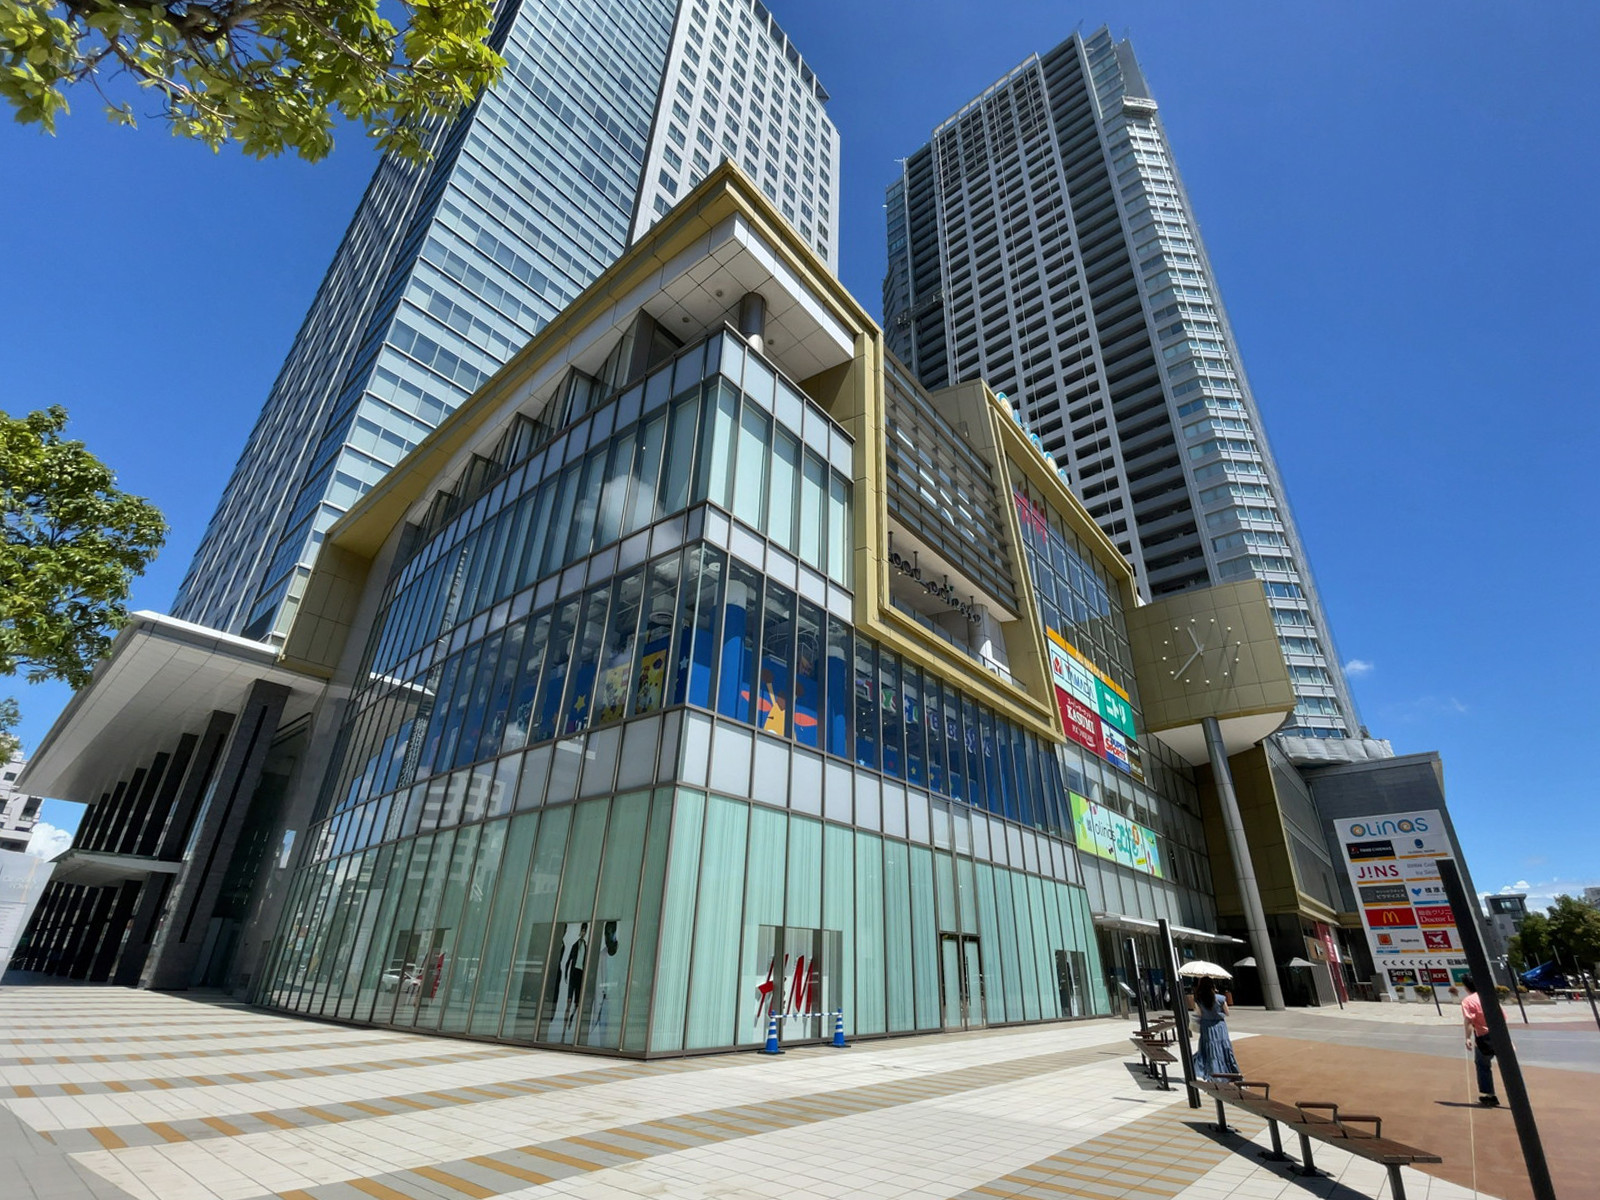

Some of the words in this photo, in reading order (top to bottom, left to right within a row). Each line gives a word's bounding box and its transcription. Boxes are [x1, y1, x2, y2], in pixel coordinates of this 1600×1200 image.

[1066, 704, 1096, 734] KASUMI
[1104, 692, 1126, 724] ニトリ
